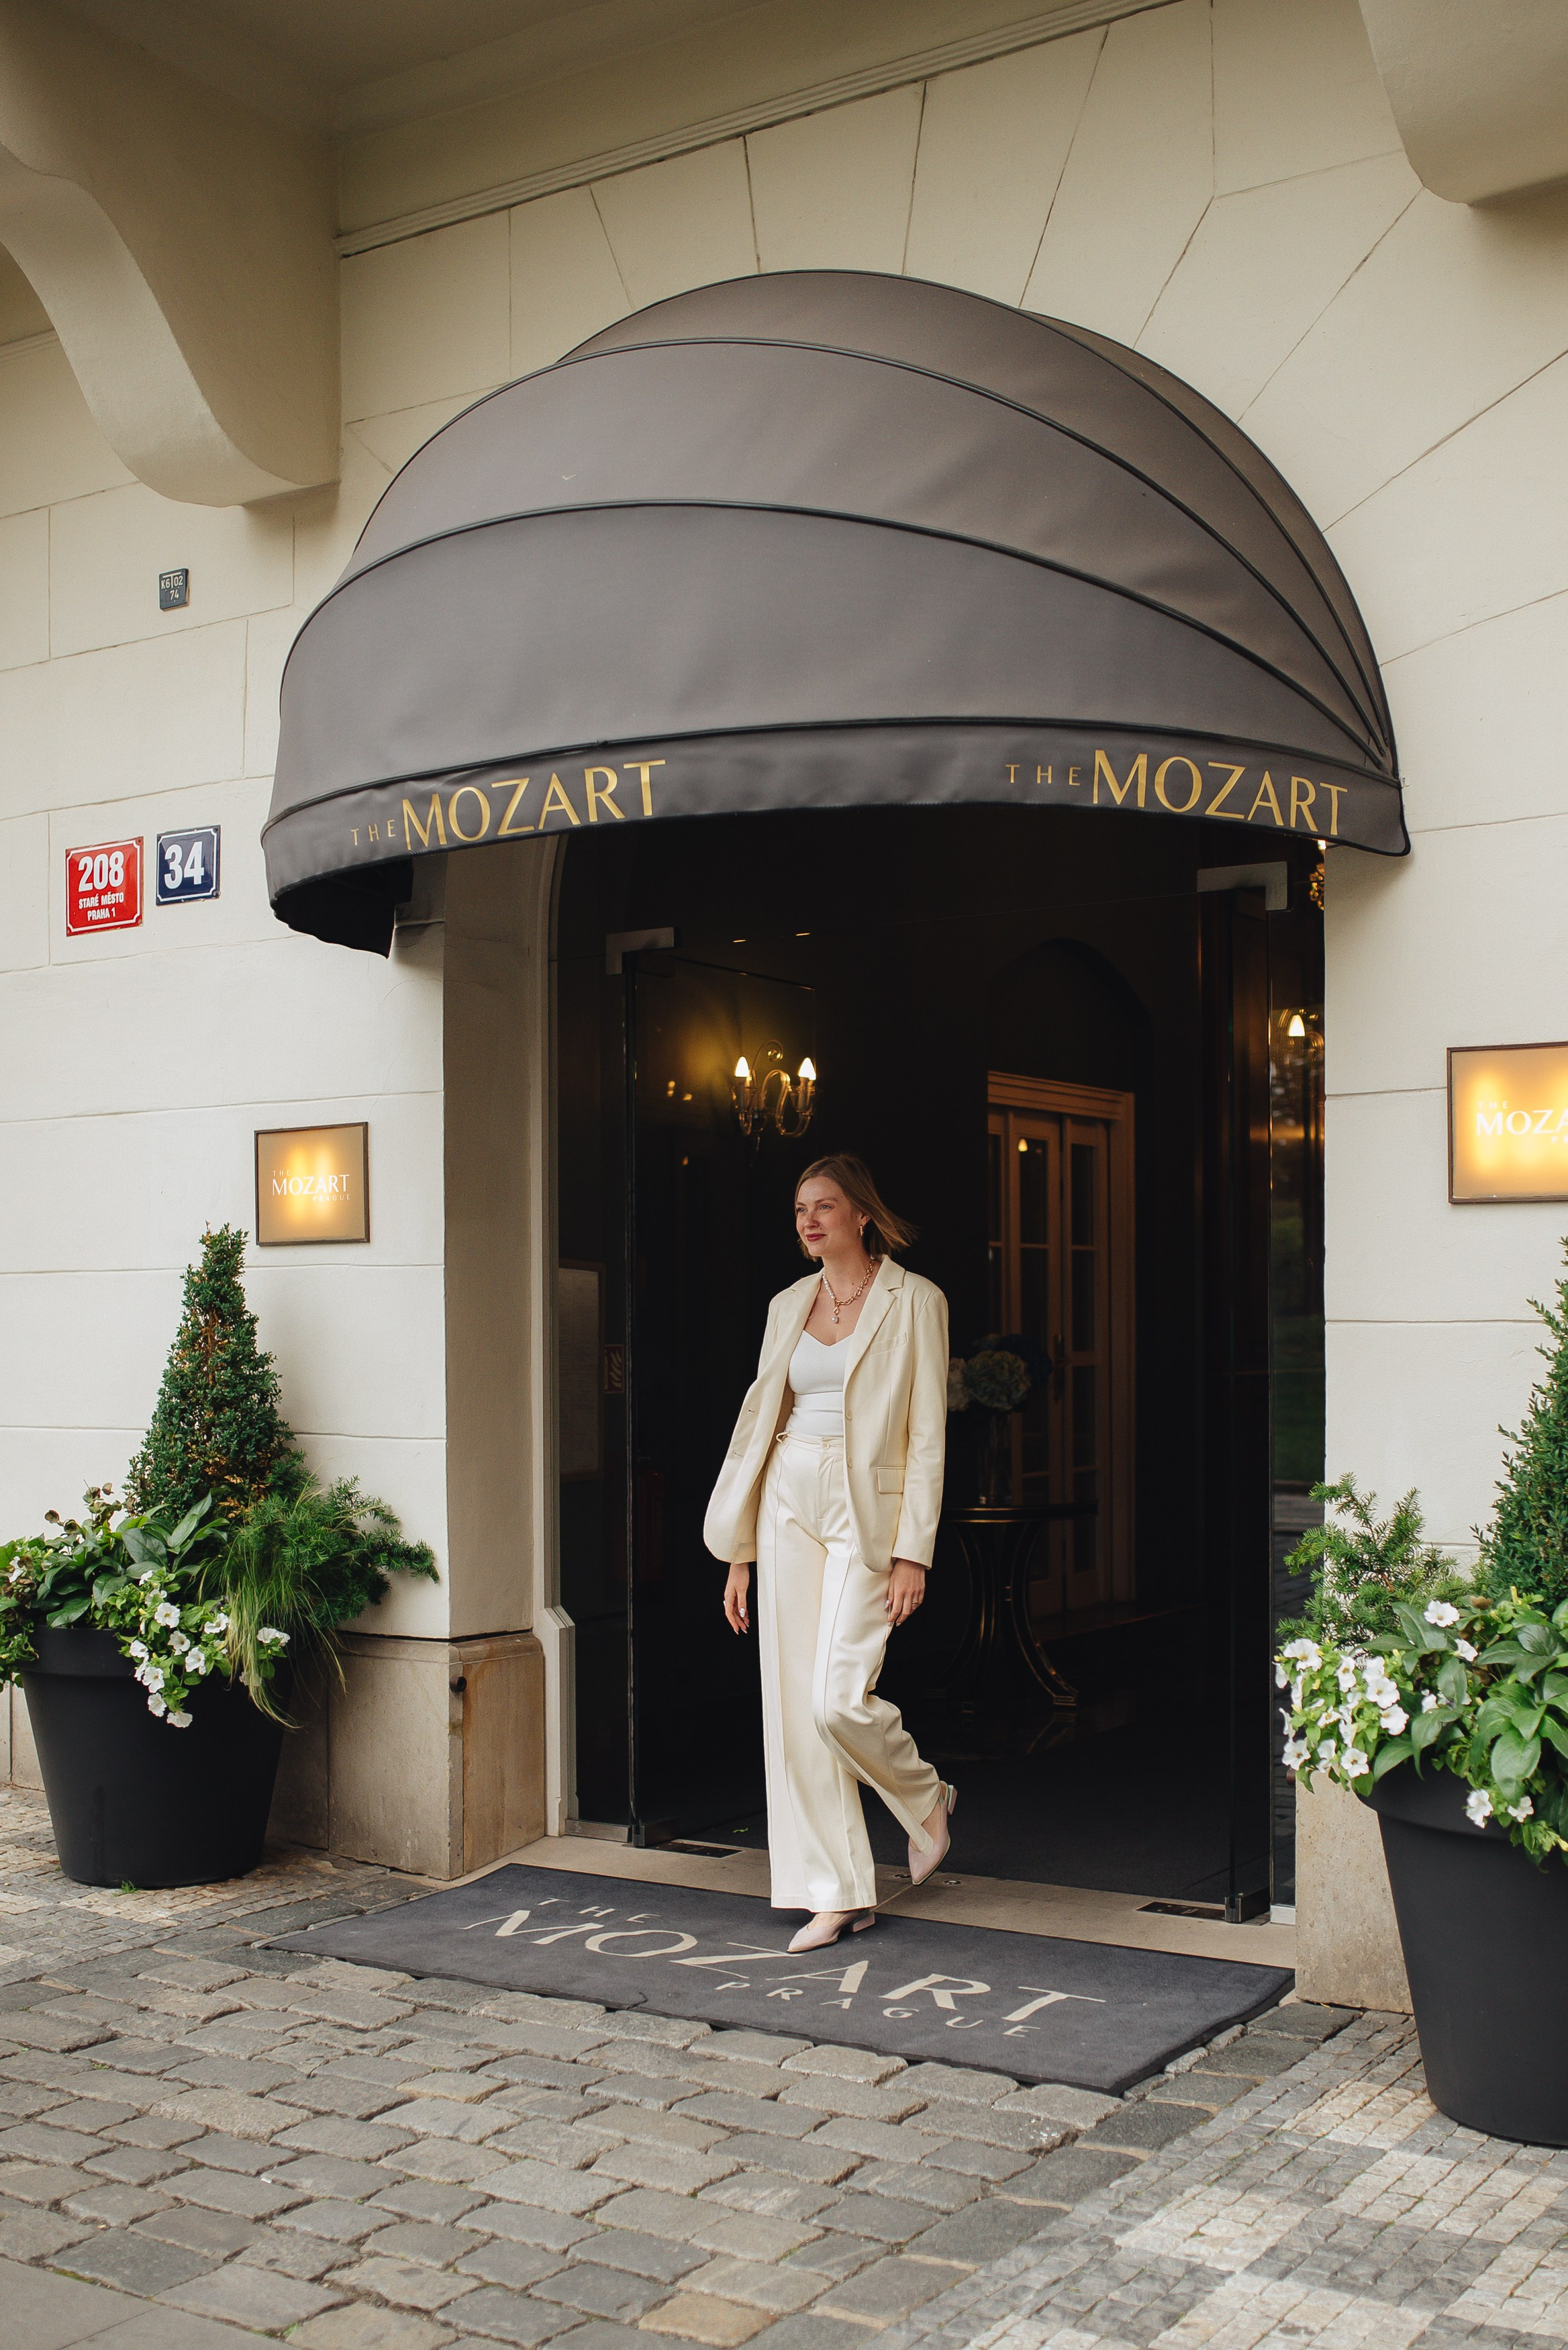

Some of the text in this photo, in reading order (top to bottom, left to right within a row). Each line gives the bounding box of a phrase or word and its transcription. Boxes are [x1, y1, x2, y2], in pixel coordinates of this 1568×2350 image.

[170, 589, 179, 600] 74
[350, 759, 666, 851] THE MOZART
[1006, 749, 1348, 836] THE MOZART
[78, 850, 125, 892] 208
[164, 841, 205, 890] 34
[79, 891, 124, 910] STARÉ MĚSTO
[87, 906, 116, 922] PRAHA 1
[1478, 1100, 1508, 1109] THE
[272, 1174, 350, 1196] MOZART
[312, 1194, 350, 1202] PRAGUE
[537, 1897, 660, 1924] THE
[457, 1910, 1106, 2022] MOZART
[715, 1981, 1041, 2037] PRAGUE
